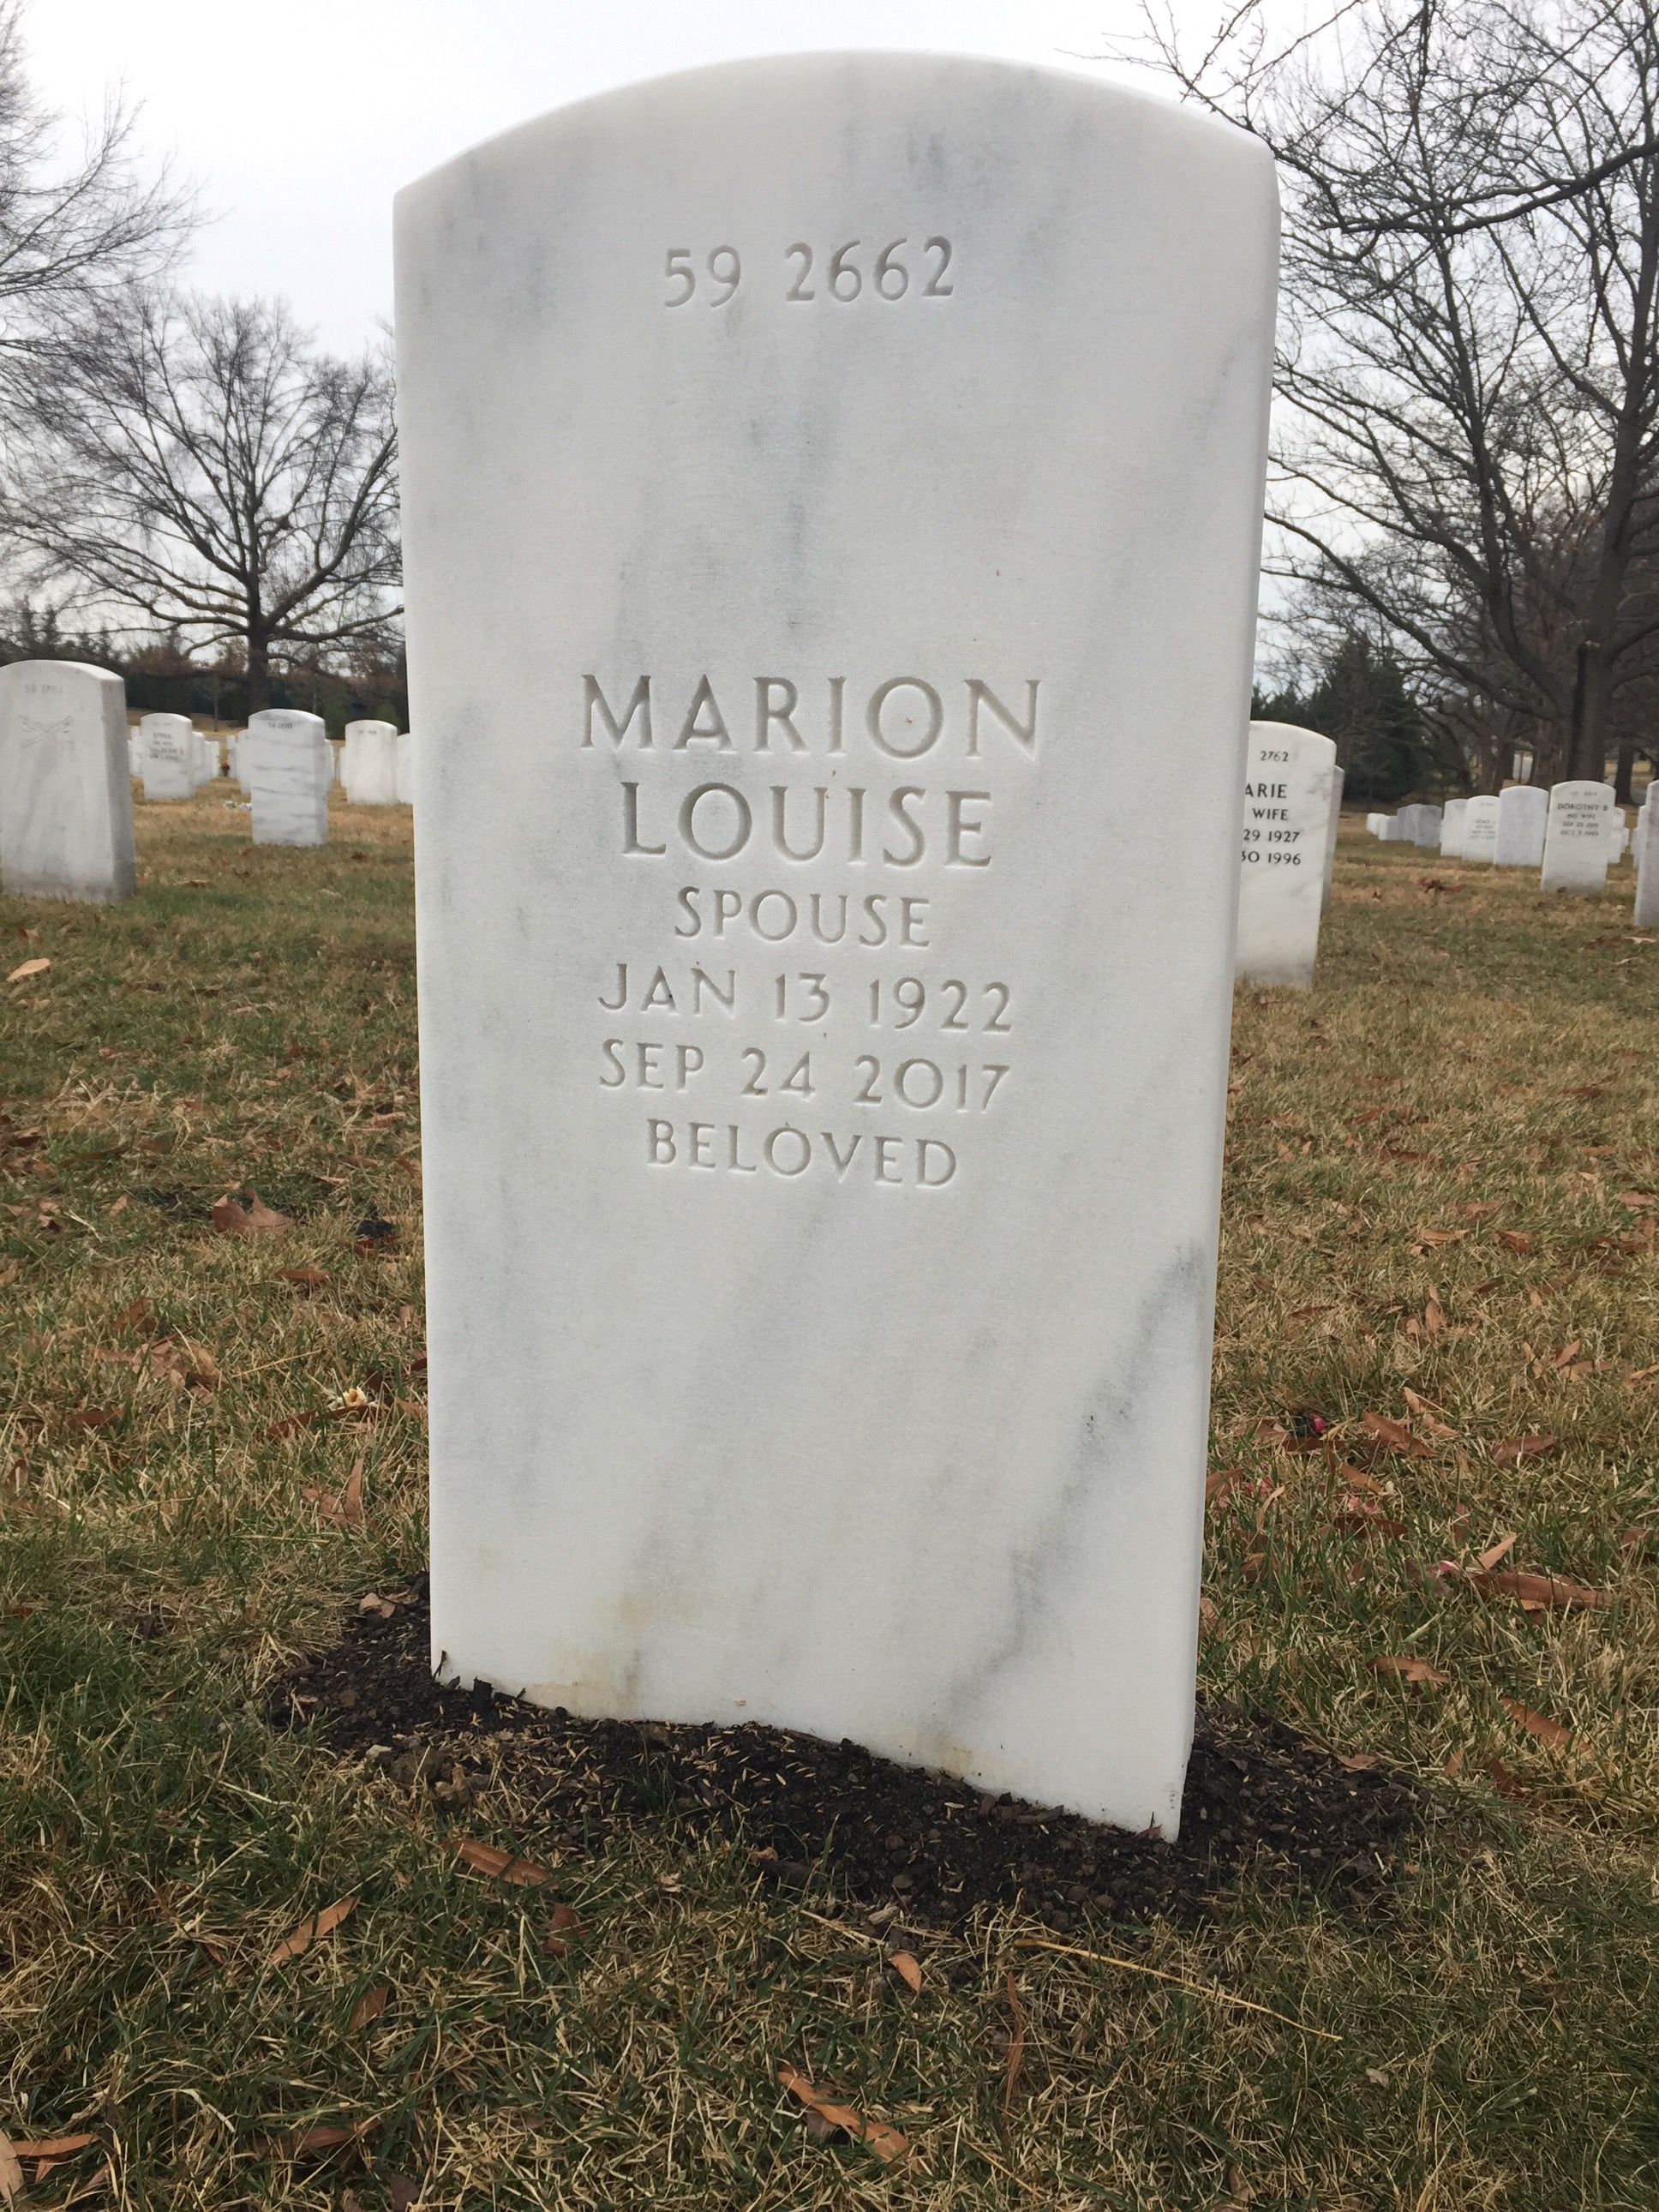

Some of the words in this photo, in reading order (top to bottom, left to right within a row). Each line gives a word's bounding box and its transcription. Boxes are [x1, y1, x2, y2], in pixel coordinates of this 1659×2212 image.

[664, 244, 741, 308] 59
[785, 235, 954, 303] 2662
[580, 674, 1041, 759] MARION
[1260, 750, 1289, 762] 2762
[1245, 783, 1287, 799] ARIE
[1253, 807, 1289, 821] WIFE
[620, 782, 992, 868] LOUISE
[1243, 828, 1261, 842] 29
[1268, 830, 1301, 842] 1927
[1268, 852, 1302, 866] 1996
[674, 885, 931, 948] SPOUSE
[599, 963, 736, 1018] JAN
[775, 973, 831, 1022] 13
[870, 977, 1013, 1033] 1922
[600, 1038, 704, 1092] SEP
[741, 1046, 817, 1099] 24
[854, 1054, 1011, 1112] 2017
[647, 1118, 957, 1188] BELOVED
